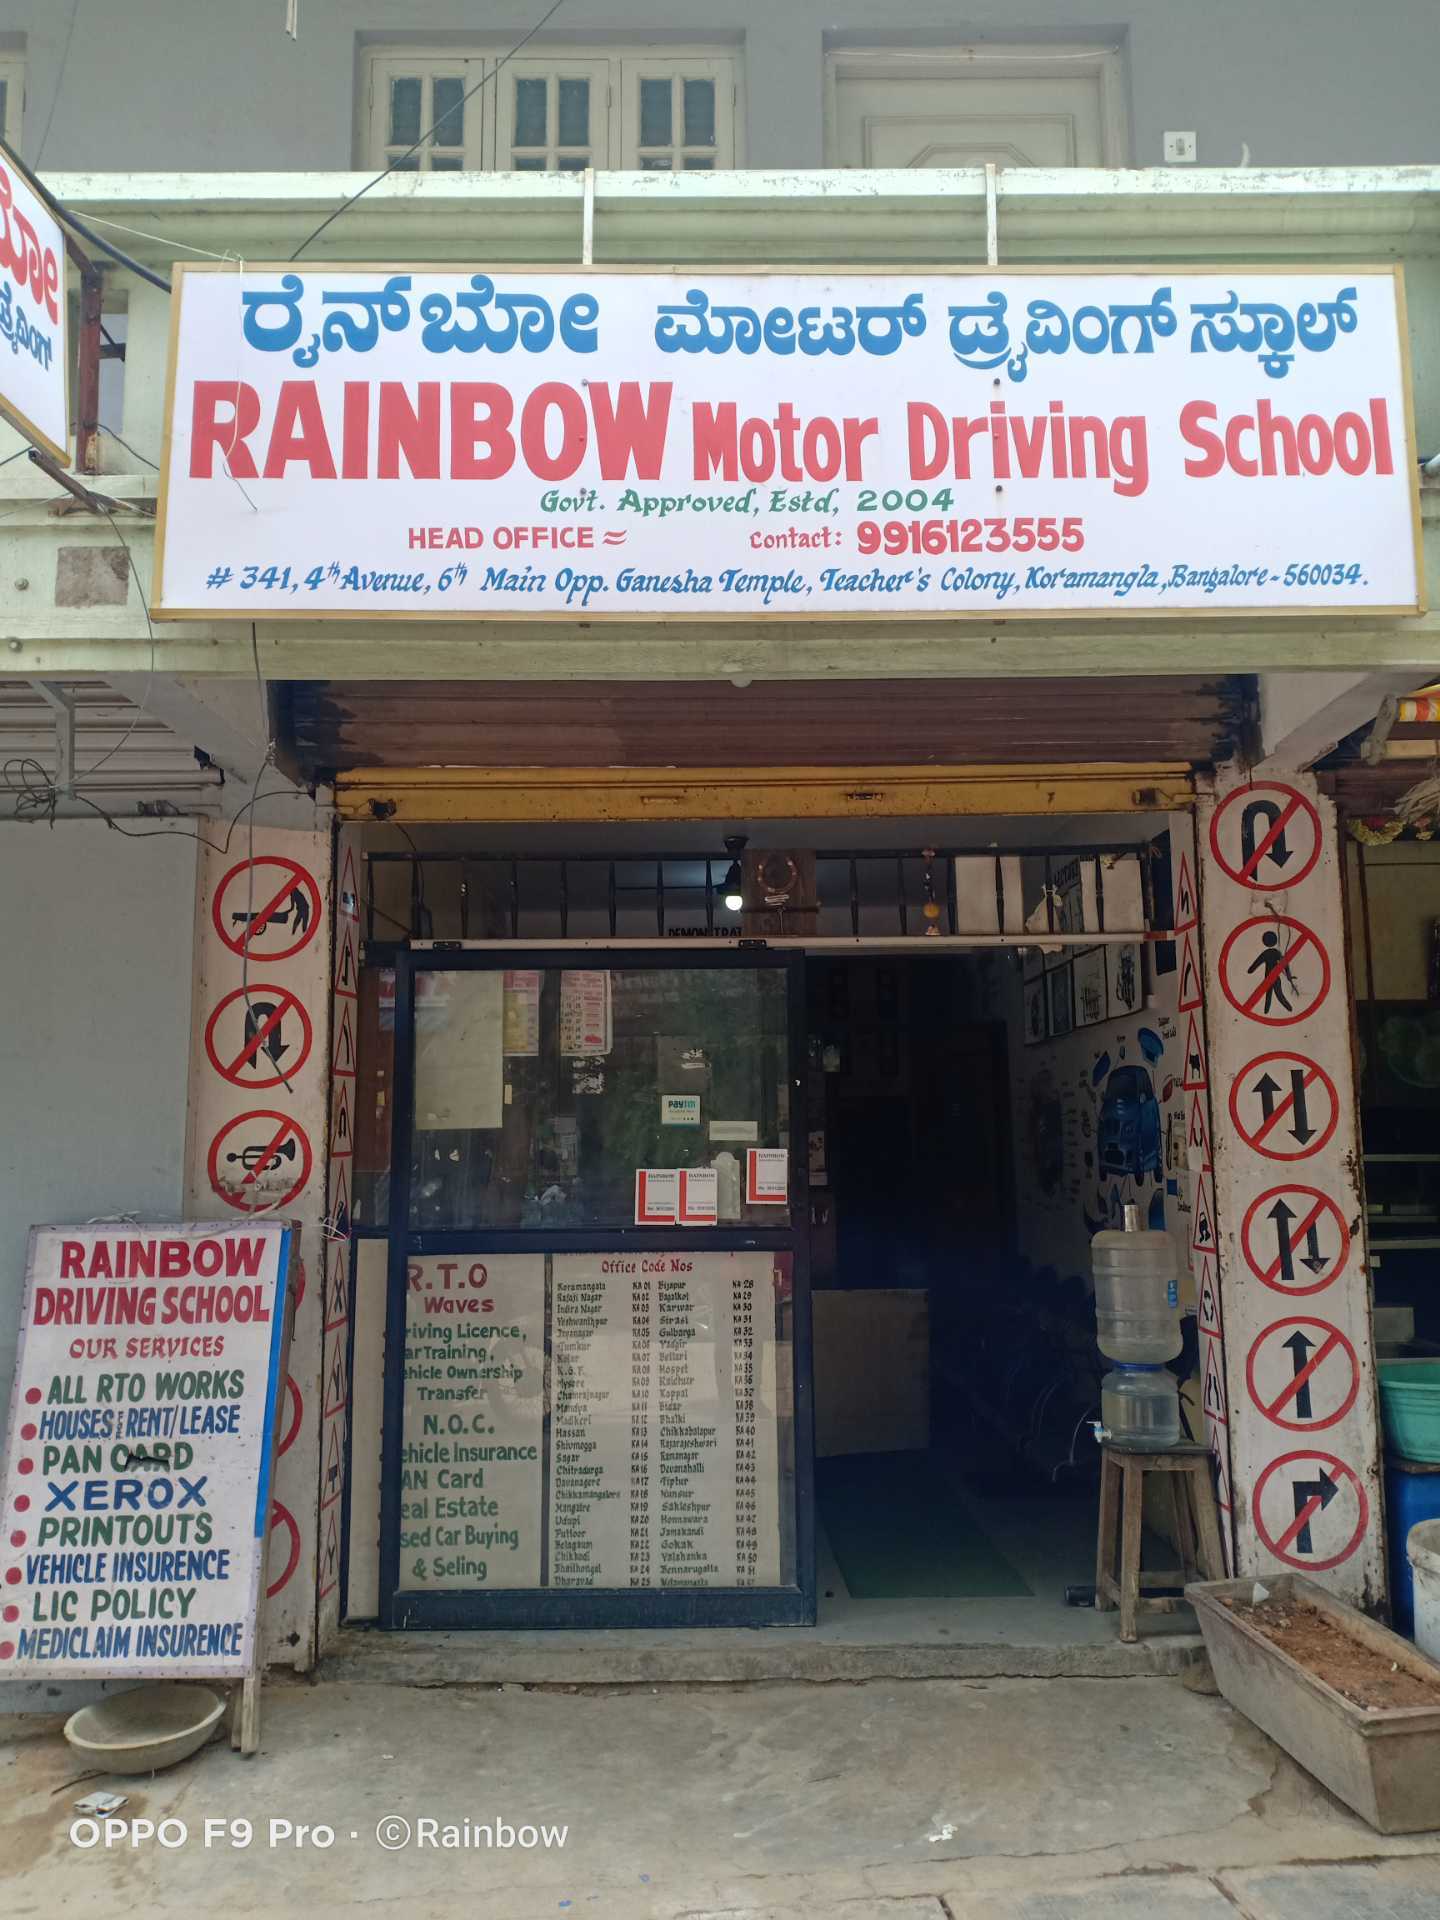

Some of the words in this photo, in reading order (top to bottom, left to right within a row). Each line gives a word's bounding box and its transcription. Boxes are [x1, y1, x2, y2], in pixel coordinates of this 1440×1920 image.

[1190, 287, 1358, 379] ಸ್ಕೂಲ್
[189, 380, 673, 481] RAINBOW
[694, 401, 878, 483] Motor
[907, 400, 1149, 497] Driving
[1179, 398, 1394, 478] School
[540, 488, 605, 513] Govt.
[616, 488, 760, 518] Approved,
[768, 488, 840, 515] Estd,
[856, 488, 955, 513] 2004
[408, 527, 484, 549] HEAD
[492, 527, 594, 549] OFFICE
[856, 517, 1086, 555] 9916123555
[240, 566, 299, 594] 341,
[480, 563, 545, 592] Main
[554, 568, 609, 606] Opp.
[616, 568, 713, 593] Ganesha
[718, 567, 812, 604] Temple,
[819, 567, 930, 593] Teacher's
[940, 566, 1021, 600] Colony,
[60, 1237, 266, 1280] RAINBOW
[601, 1261, 636, 1274] Office
[641, 1259, 665, 1273] Code
[670, 1258, 693, 1273] Nos
[33, 1287, 156, 1326] DRIVING
[161, 1284, 270, 1325] SCHOOL
[424, 1297, 494, 1314] Waves
[70, 1338, 117, 1359] OUR
[125, 1335, 224, 1358] SERVICES
[404, 1324, 452, 1343] riving
[457, 1324, 527, 1342] Licence,
[402, 1346, 422, 1360] ar
[423, 1344, 494, 1364] Training,
[47, 1375, 87, 1405] ALL
[97, 1372, 146, 1403] RTO
[155, 1369, 245, 1400] WORKS
[402, 1365, 442, 1380] ehicle
[446, 1366, 523, 1384] Ownership
[417, 1386, 485, 1402] Transfer
[39, 1408, 113, 1440] HOUSES
[125, 1404, 241, 1440] RENT/LEASE
[423, 1414, 495, 1435] N.O.C.
[556, 1429, 586, 1439] Hassan
[42, 1443, 102, 1476] PAN
[110, 1441, 193, 1473] CARD
[400, 1441, 449, 1463] ehicle
[453, 1444, 537, 1463] Insurance
[401, 1469, 428, 1490] AN
[437, 1468, 484, 1489] Card
[44, 1476, 208, 1512] XEROX
[400, 1497, 429, 1519] eal
[435, 1496, 499, 1519] Estate
[37, 1512, 213, 1547] PRINTOUTS
[399, 1525, 431, 1548] sed
[435, 1527, 461, 1547] Car
[464, 1522, 519, 1550] Buying
[26, 1552, 107, 1585] VEHICLE
[112, 1549, 230, 1583] INSURENCE
[412, 1557, 427, 1580] &
[433, 1556, 488, 1580] Seling
[32, 1590, 78, 1622] LIC
[90, 1587, 197, 1622] POLICY
[16, 1625, 131, 1660] MEDICLAIM
[136, 1622, 243, 1658] INSURENCE
